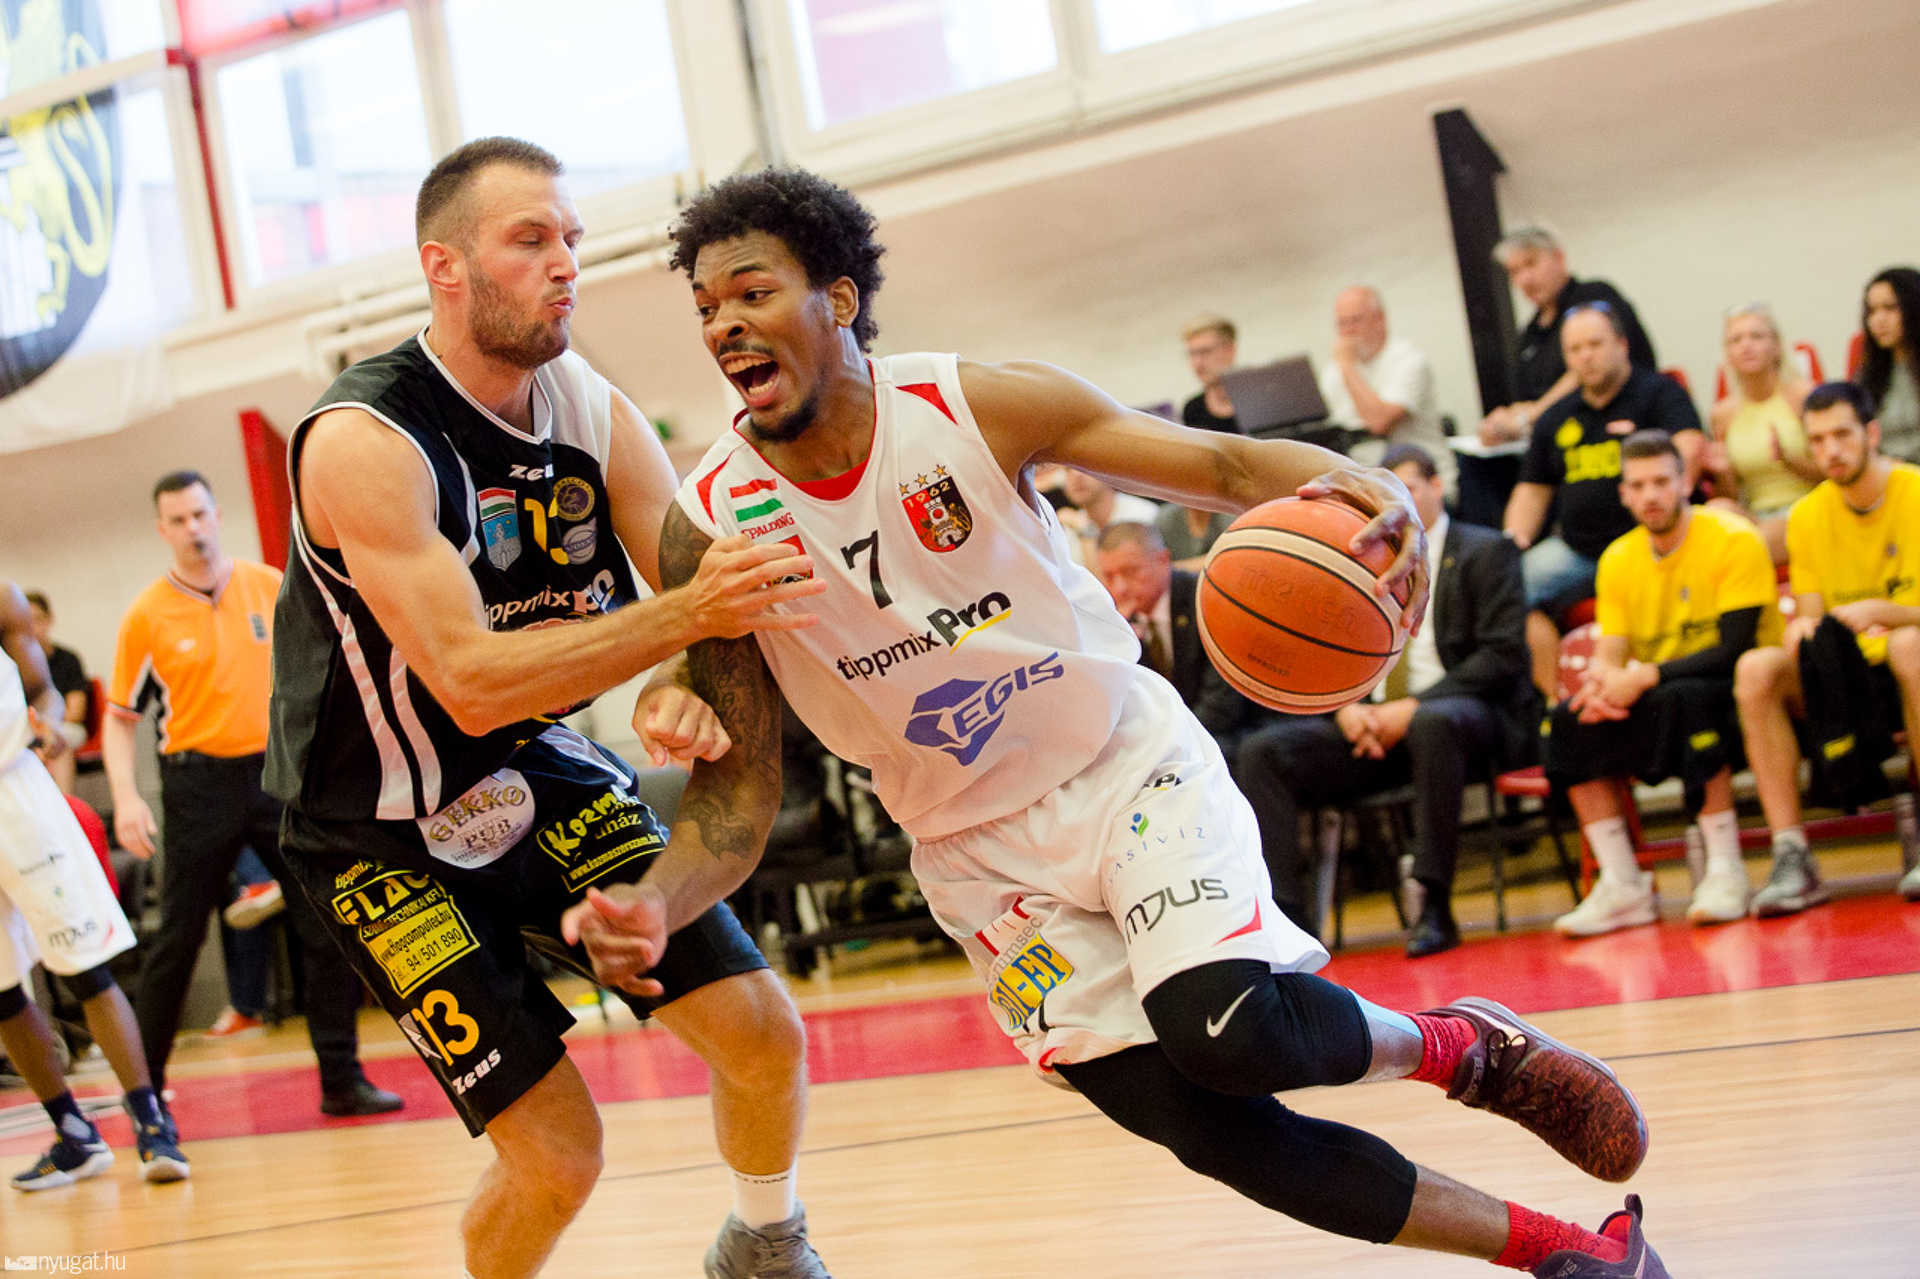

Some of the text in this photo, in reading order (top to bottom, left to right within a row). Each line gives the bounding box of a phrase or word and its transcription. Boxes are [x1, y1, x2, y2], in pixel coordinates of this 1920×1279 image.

[906, 481, 951, 508] 1962
[840, 530, 893, 609] 7
[952, 651, 1064, 738] EGIS
[430, 786, 526, 842] GEKKO
[411, 988, 480, 1067] 13
